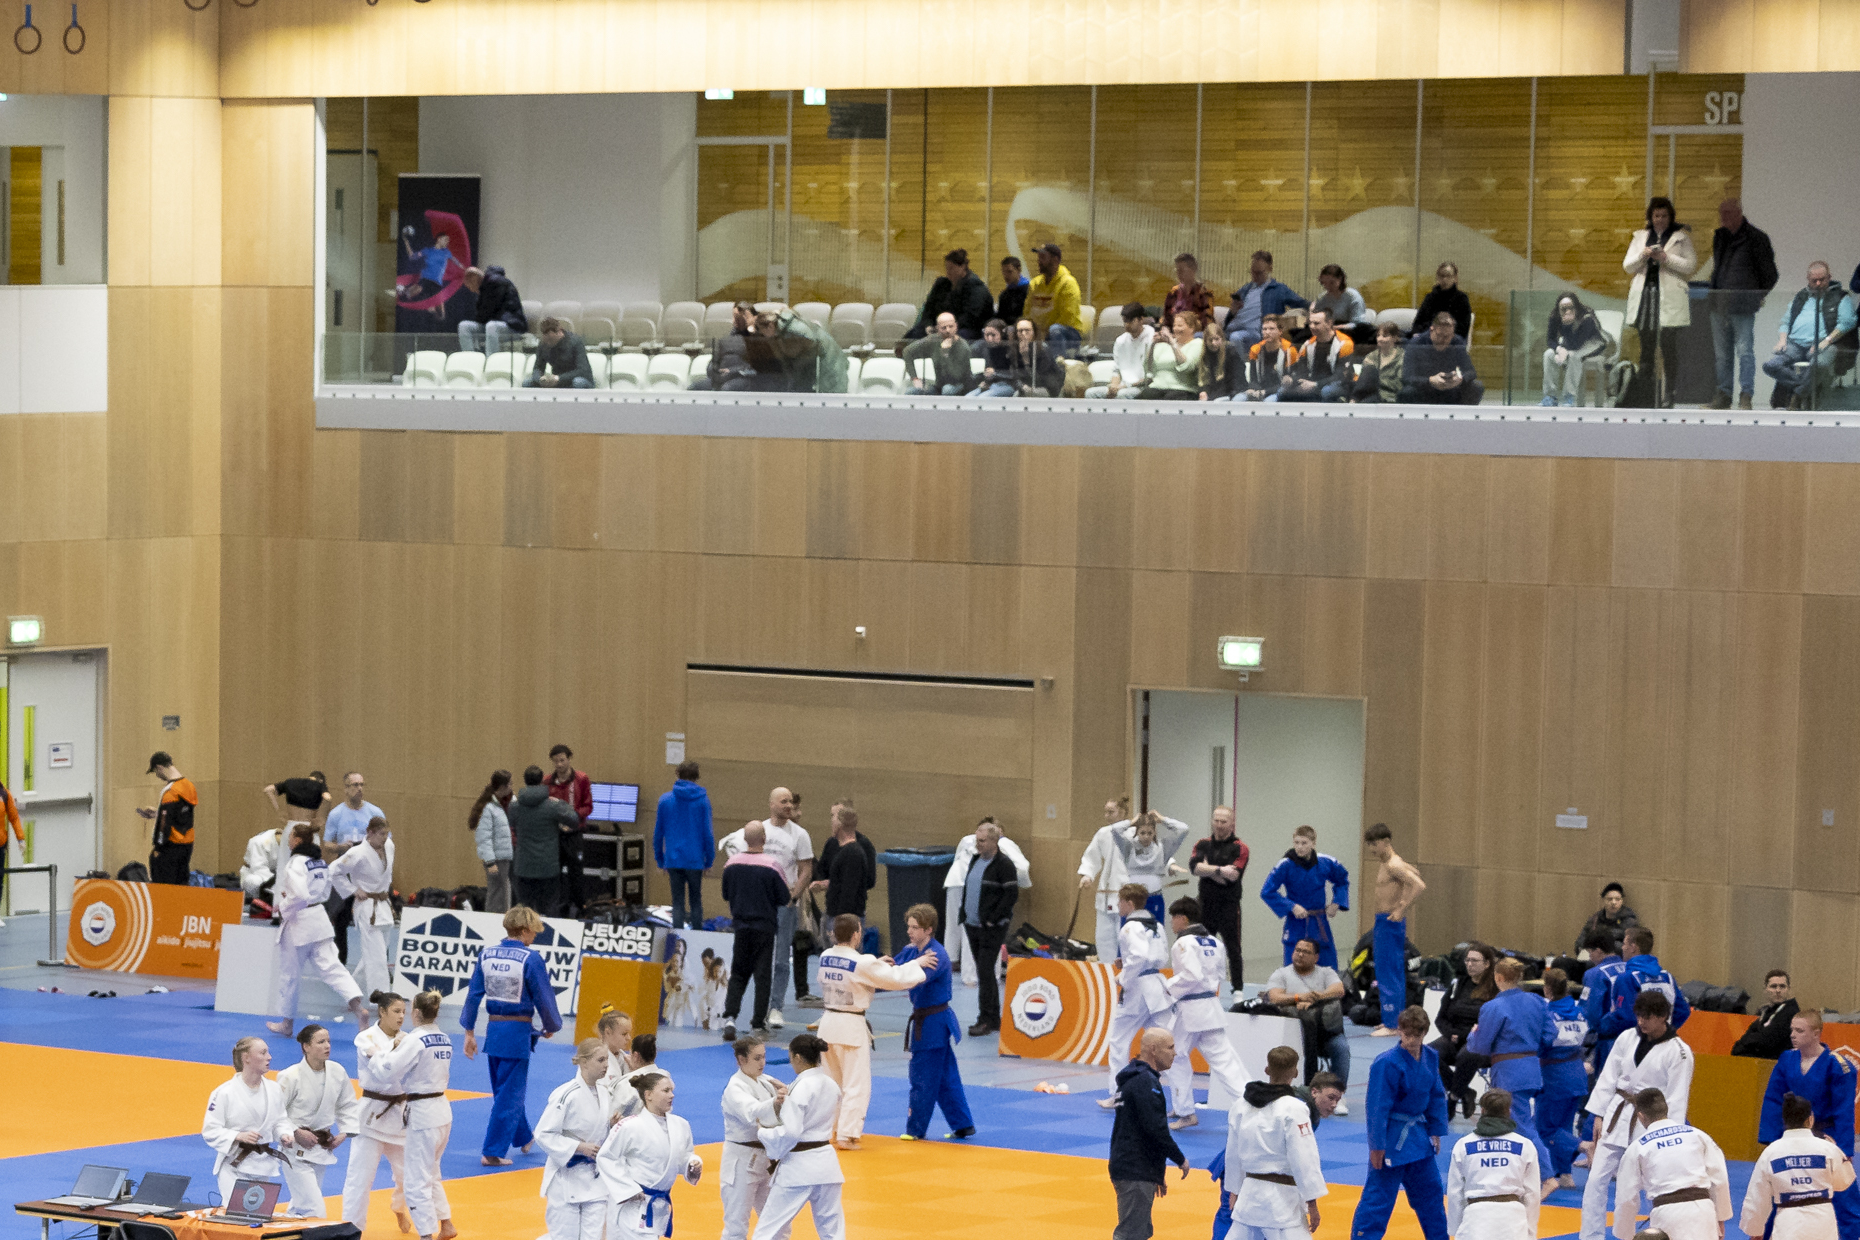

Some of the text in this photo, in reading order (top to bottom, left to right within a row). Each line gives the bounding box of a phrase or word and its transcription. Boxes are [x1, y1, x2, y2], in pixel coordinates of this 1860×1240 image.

[180, 915, 212, 936] JBN
[584, 923, 652, 941] JEUGD
[402, 938, 485, 958] BOUW
[582, 937, 651, 956] FONDS
[491, 963, 511, 972] NED
[824, 971, 844, 981] NED
[433, 1050, 452, 1060] NED
[1476, 1140, 1512, 1151] DE VRIES
[1656, 1137, 1683, 1150] NED
[1480, 1158, 1509, 1168] NED
[1790, 1176, 1813, 1186] NED
